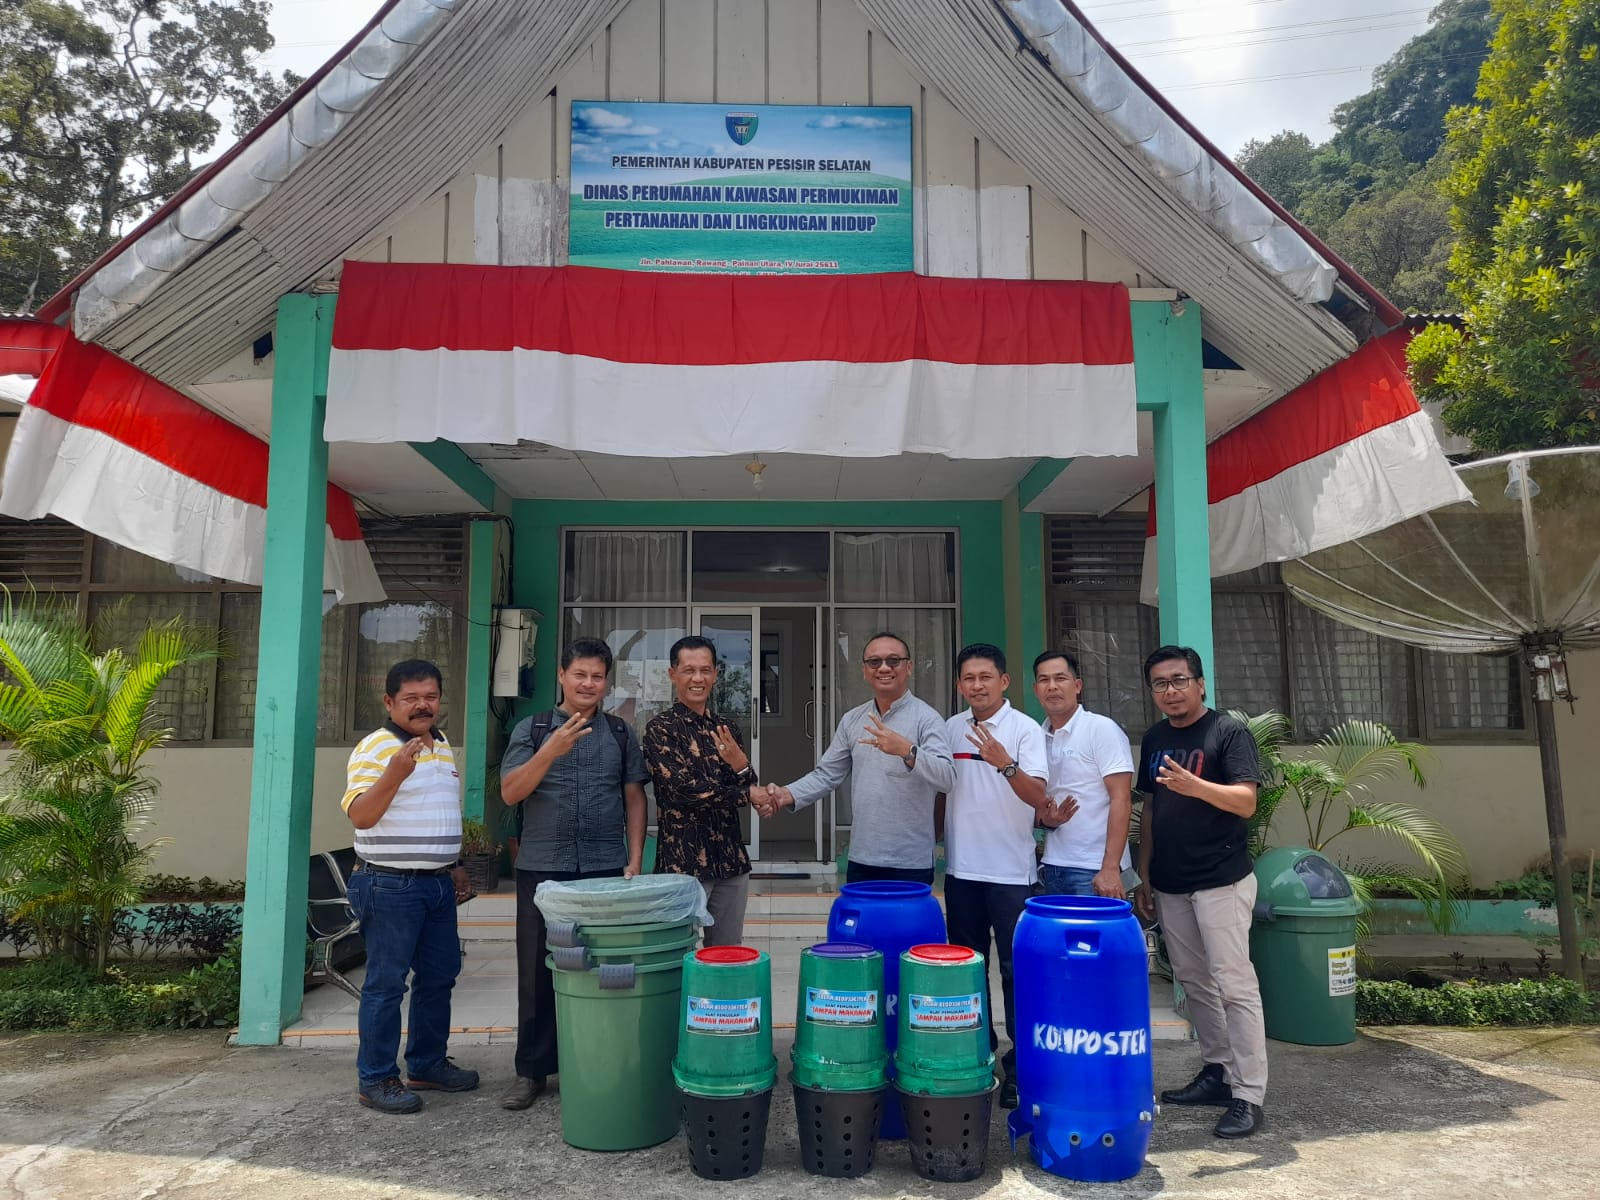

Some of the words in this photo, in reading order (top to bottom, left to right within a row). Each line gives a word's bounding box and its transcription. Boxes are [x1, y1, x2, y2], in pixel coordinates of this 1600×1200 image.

[612, 155, 690, 169] PEMERINTAH
[693, 156, 764, 170] KABUPATEN
[767, 158, 815, 171] PESISIR
[818, 159, 871, 172] SELATAN
[583, 184, 629, 201] DINAS
[632, 185, 722, 202] PERUMAHAN
[725, 186, 797, 203] KAWASAN
[801, 187, 898, 205] PERMUKIMAN
[605, 212, 699, 229] PERTANAHAN
[703, 213, 731, 230] DAN
[735, 213, 828, 231] LINGKUNGAN
[831, 215, 876, 232] HIDUP
